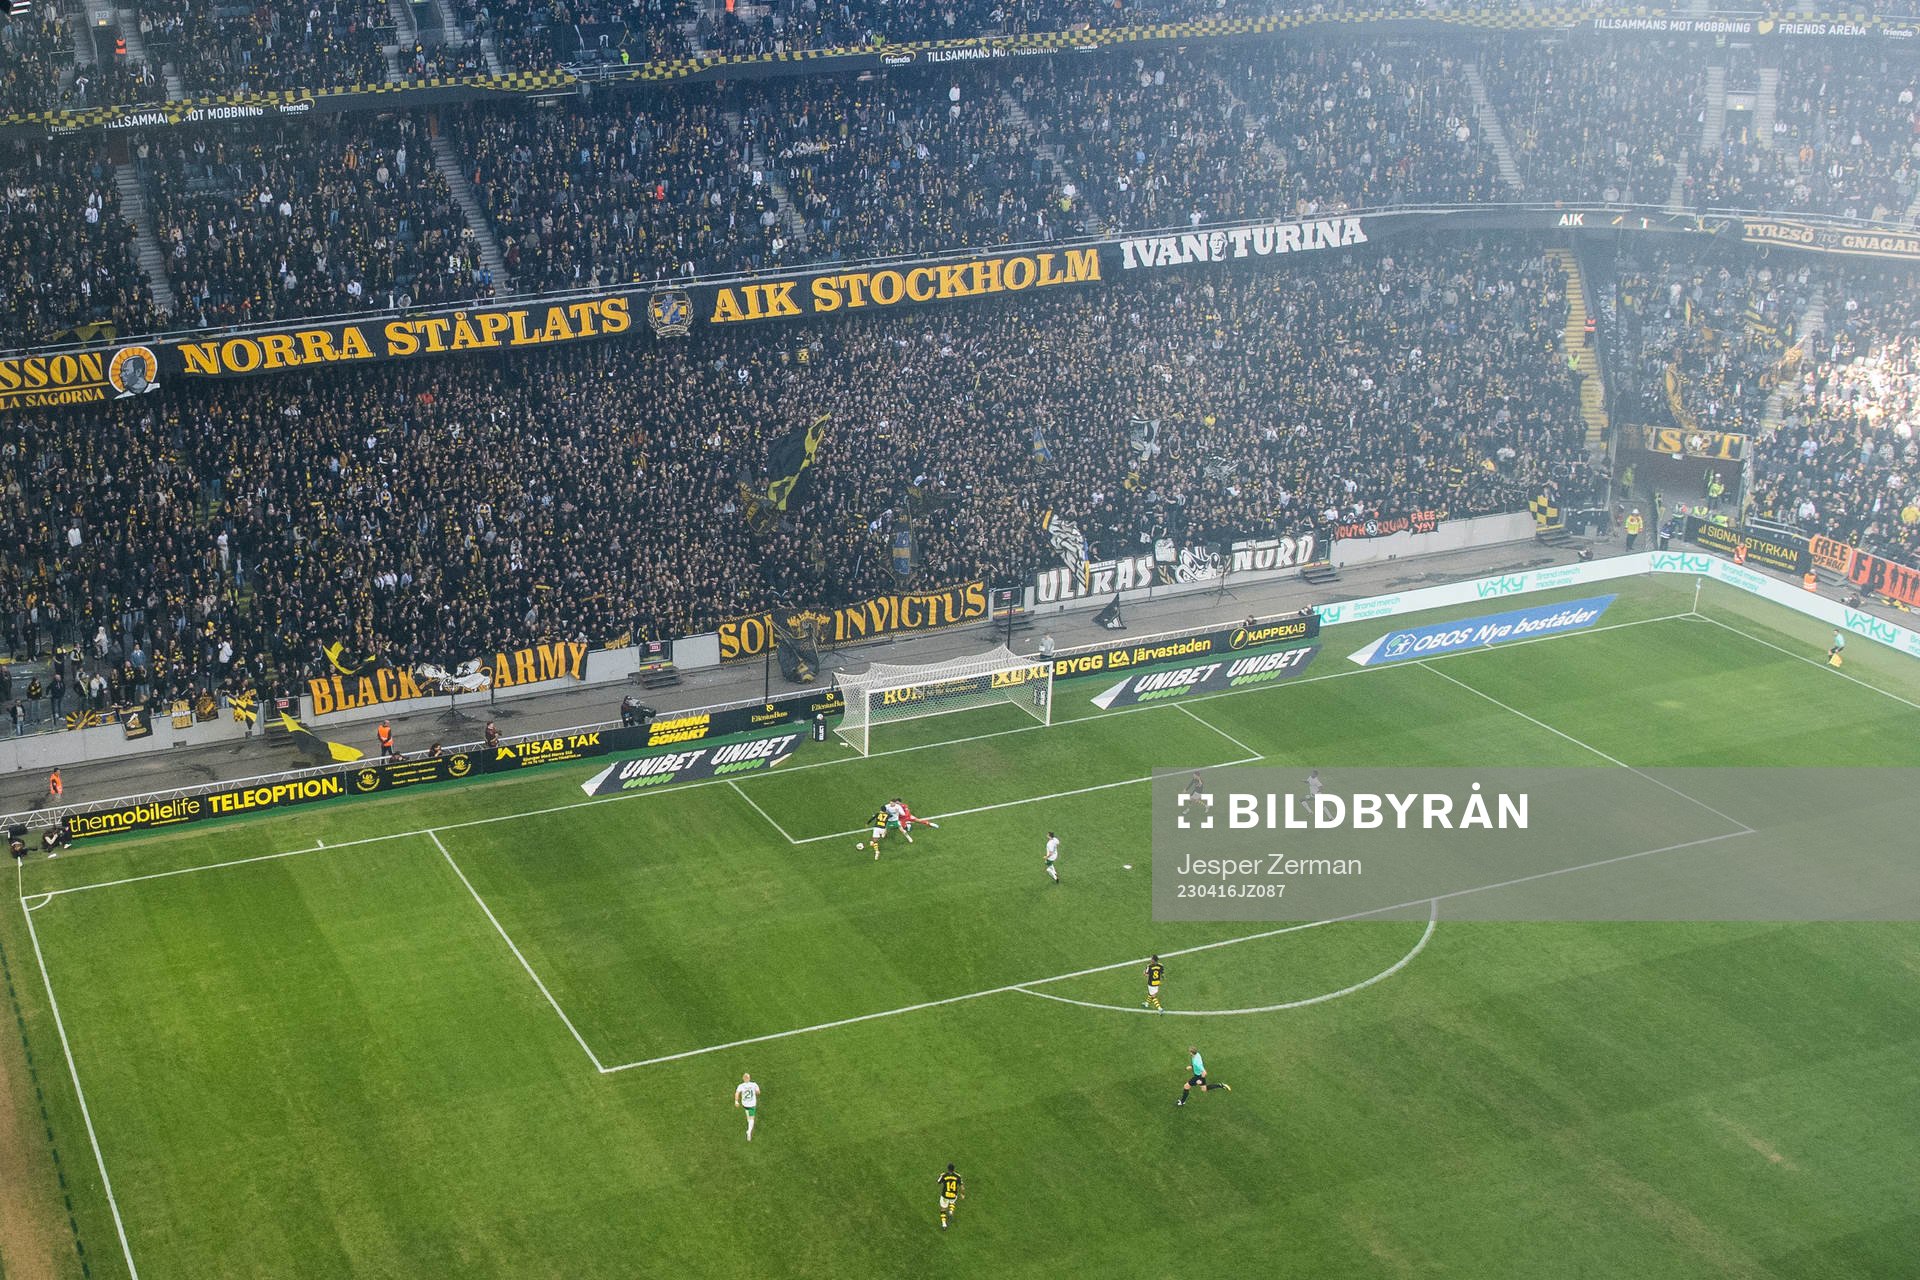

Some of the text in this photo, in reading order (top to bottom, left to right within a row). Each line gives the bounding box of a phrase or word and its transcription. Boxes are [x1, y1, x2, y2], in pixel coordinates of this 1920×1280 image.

[1594, 19, 1751, 34] TILLSAMMANS MOT MOBBNING
[1778, 23, 1867, 37] FRIENDS ARENA
[885, 54, 911, 65] friends
[927, 48, 990, 63] TILLSAMMANS
[207, 104, 264, 120] MOBBNING
[279, 102, 309, 113] friends
[1558, 212, 1585, 227] AIK
[1743, 221, 1815, 243] TYRESÖ
[1119, 217, 1369, 270] IVAN TURINA
[710, 248, 1102, 324] AIK STOCKHOLM
[177, 297, 632, 375] NORRA STÅPLATS
[25, 385, 106, 408] SAGORNA
[1410, 510, 1436, 524] FREE
[1335, 523, 1366, 541] YOUTH
[1706, 524, 1744, 546] SIGNAL
[1745, 537, 1799, 562] STYRKAN
[1814, 538, 1849, 562] FREE
[834, 581, 988, 641] INVICTUS
[1247, 622, 1306, 642] KAPPEXAB
[1413, 608, 1598, 652] OBOS Nya bostäder
[1108, 638, 1211, 666] ICA Järvastaden
[307, 666, 422, 715] BLACK
[494, 642, 589, 690] ARMY
[1027, 654, 1104, 681] XL-BYGG
[1133, 647, 1312, 694] UNIBET UNIBET
[649, 713, 711, 733] BRUNNA
[515, 737, 564, 757] TISAB
[566, 732, 600, 749] TAK
[647, 727, 710, 747] SCHAKT
[619, 749, 708, 780] UNIBET
[710, 733, 797, 766] UNIBET
[208, 776, 344, 813] TELEOPTION.
[69, 798, 200, 833] themobilelife
[1152, 969, 1159, 980] 8
[744, 1089, 754, 1099] 21
[946, 1181, 957, 1191] 14
